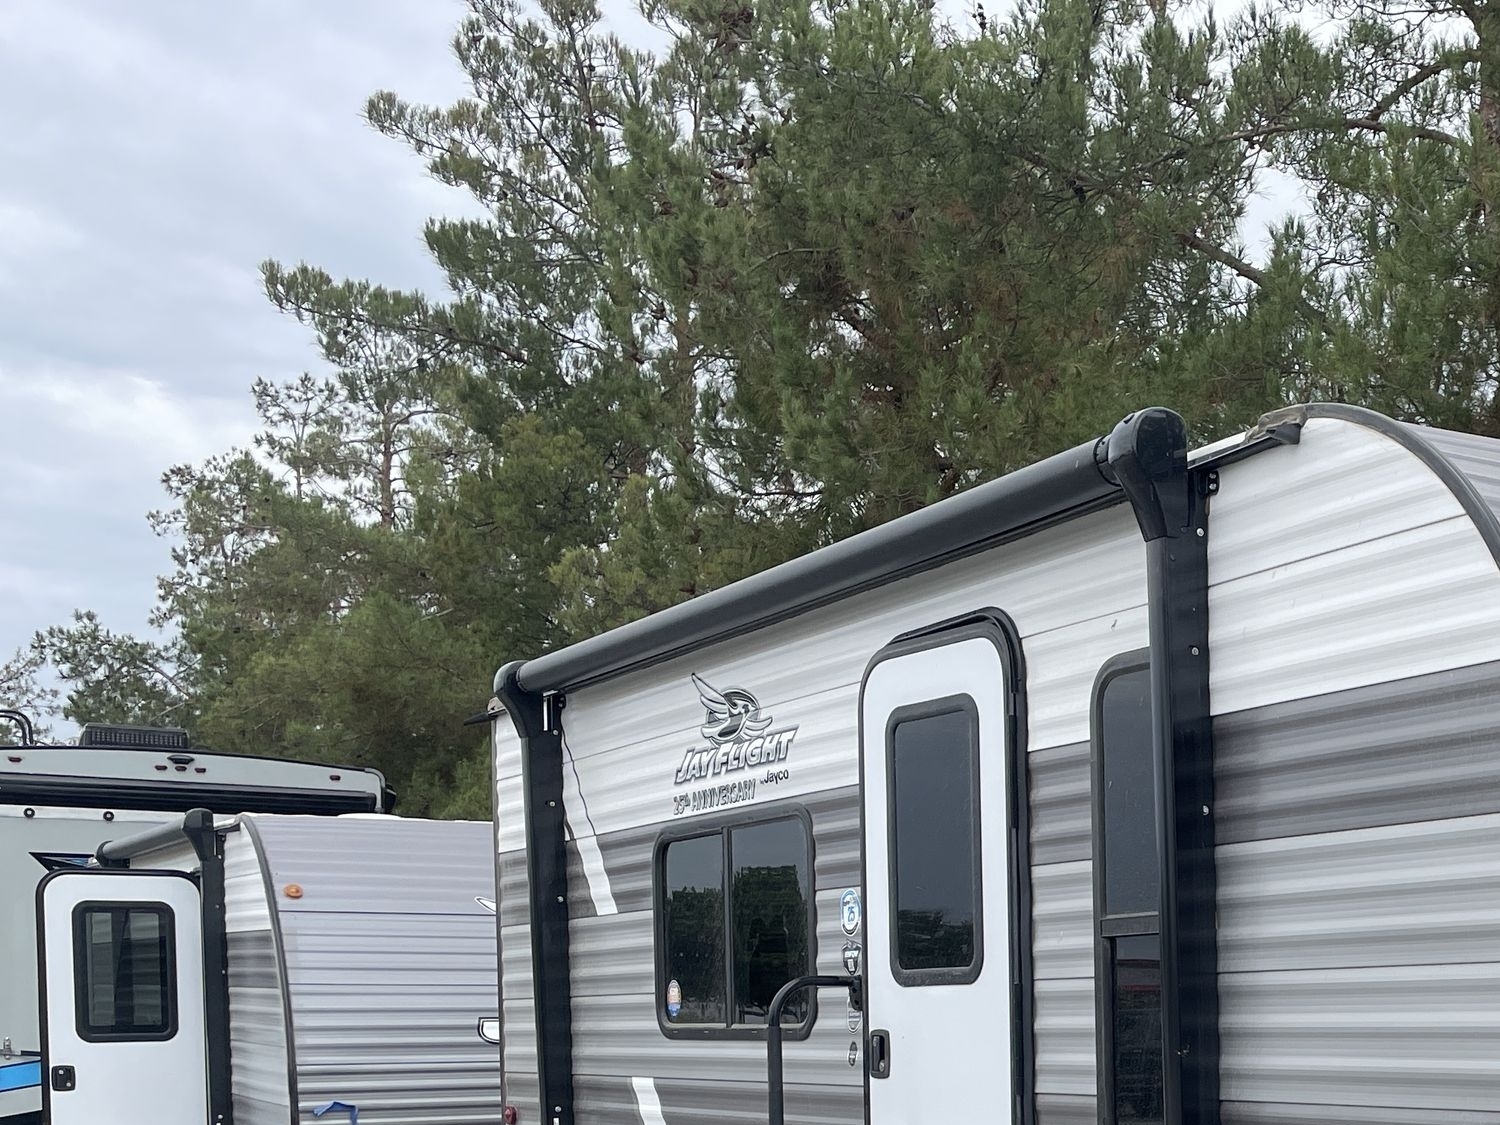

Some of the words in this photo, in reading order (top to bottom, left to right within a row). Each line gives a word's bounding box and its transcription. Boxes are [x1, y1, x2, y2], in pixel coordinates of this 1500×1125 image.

[674, 746, 718, 785] JAY
[713, 725, 799, 775] FLIGHT
[764, 769, 789, 785] Jayco
[691, 778, 756, 812] ANNIVERSARY
